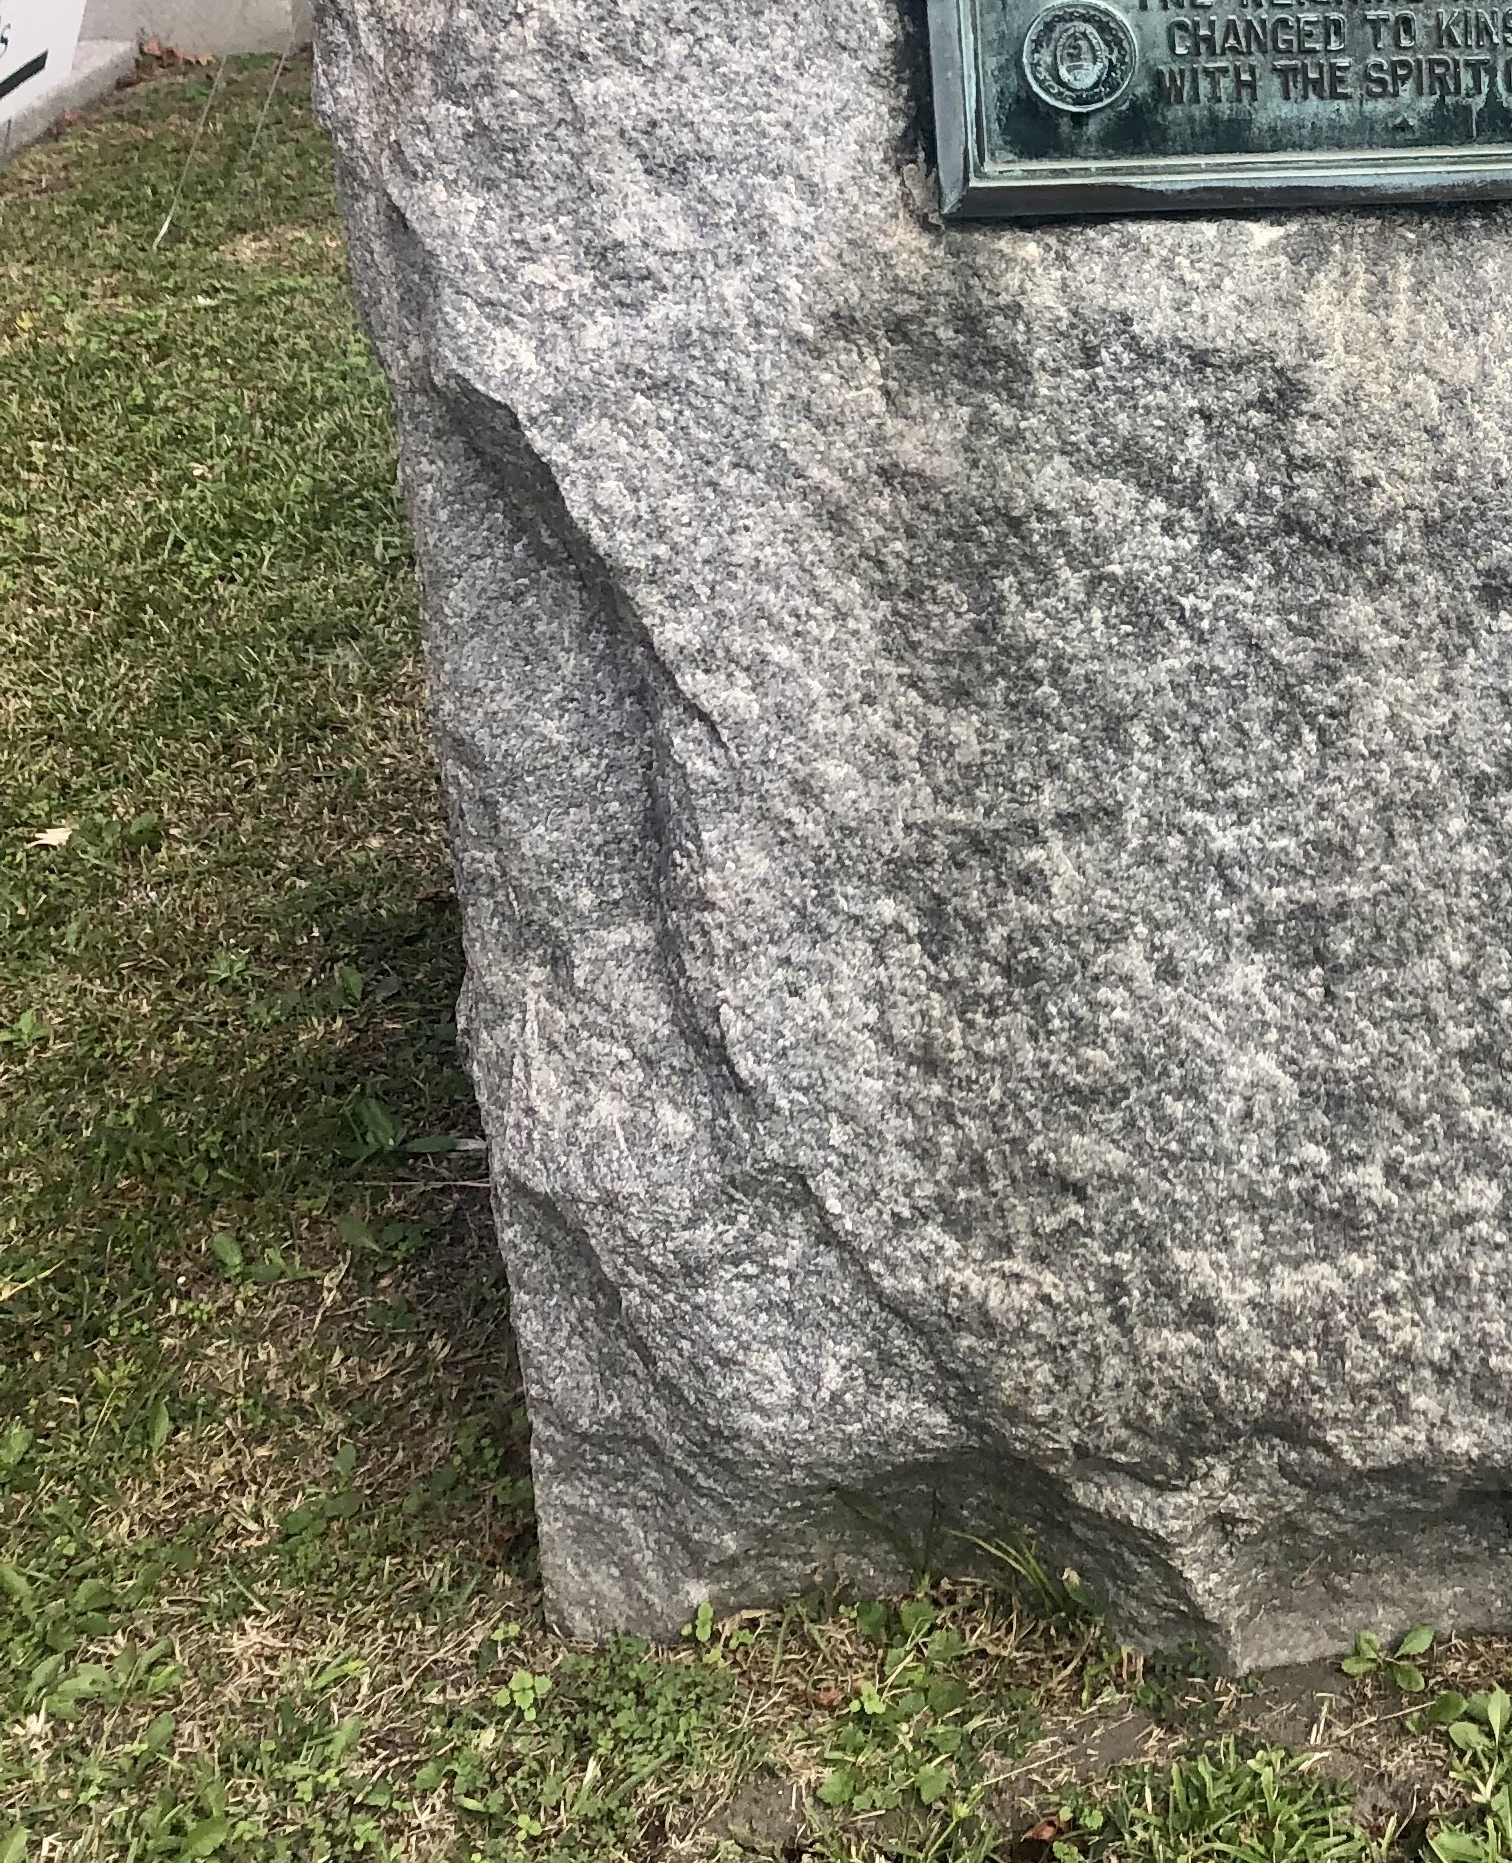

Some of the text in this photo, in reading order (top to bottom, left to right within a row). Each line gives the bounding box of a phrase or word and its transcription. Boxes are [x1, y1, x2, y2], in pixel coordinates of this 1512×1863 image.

[1167, 12, 1346, 57] CHANGED
[1365, 11, 1417, 50] TO
[1156, 63, 1259, 105] WITH
[1276, 61, 1353, 101] THE
[1364, 57, 1491, 99] SPIRIT
